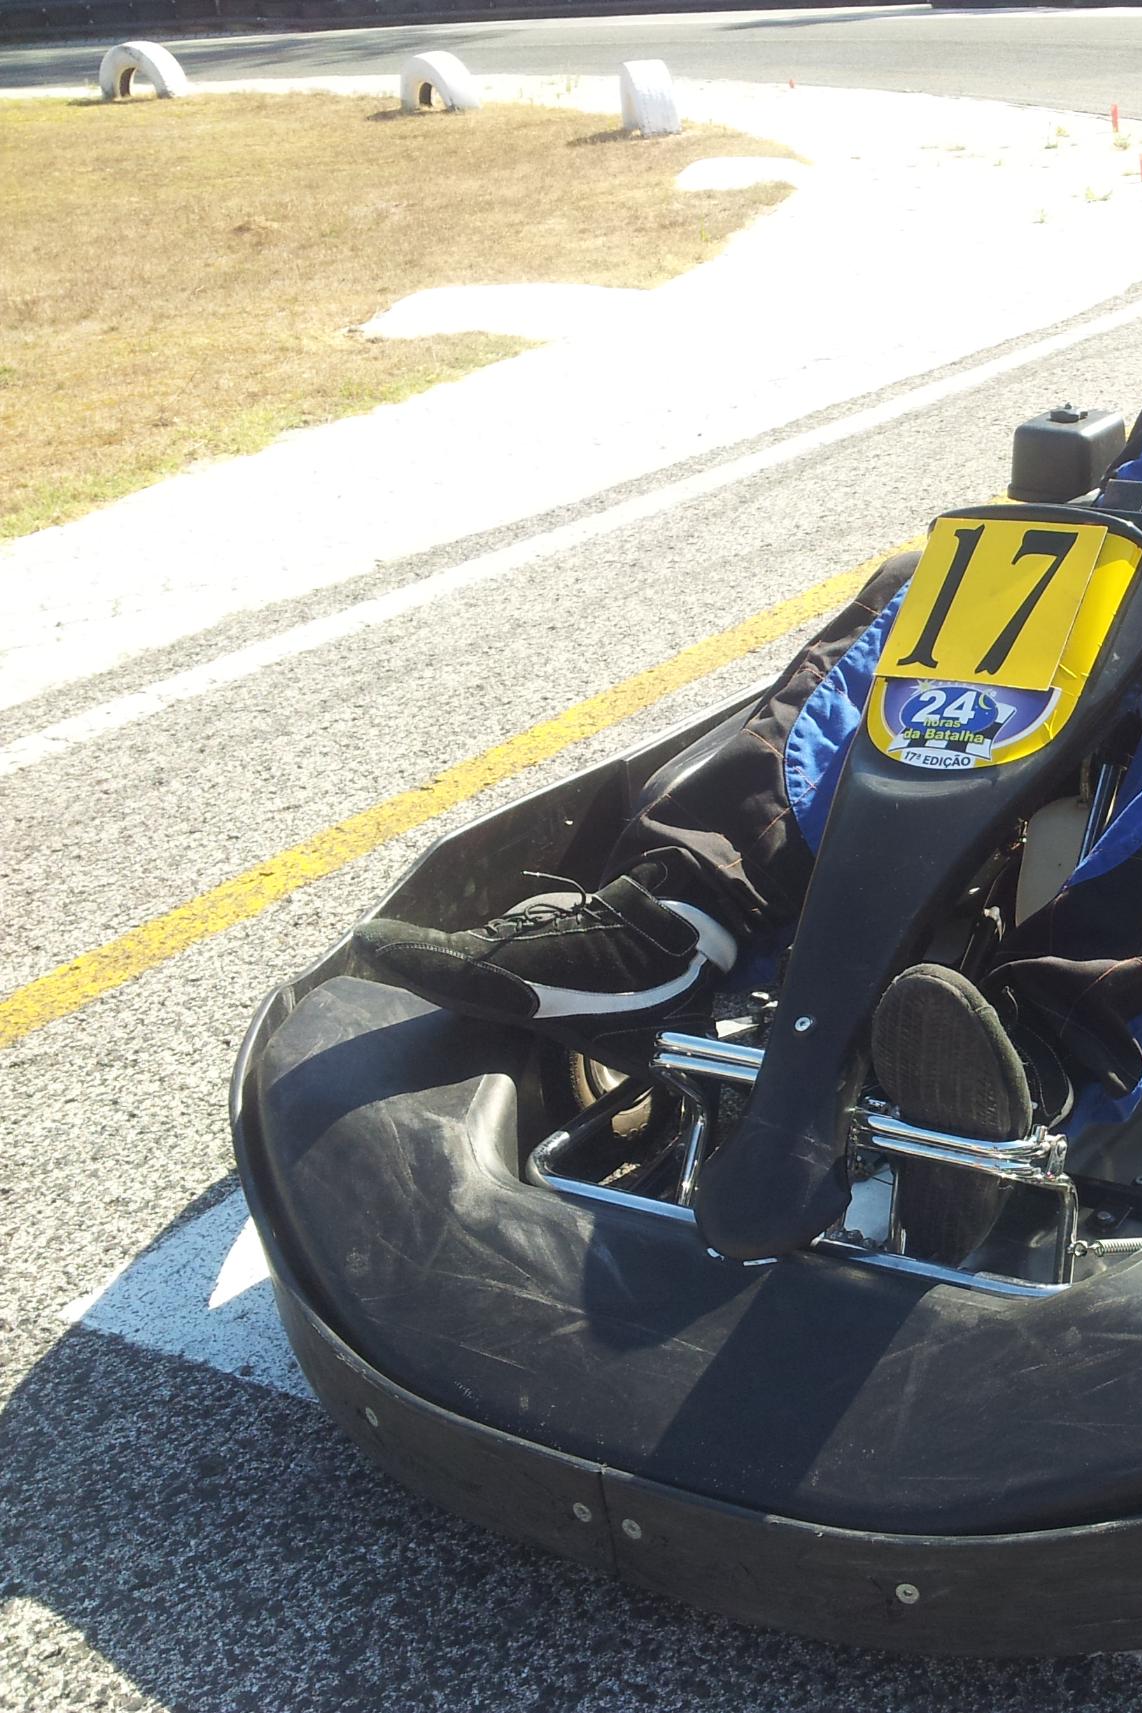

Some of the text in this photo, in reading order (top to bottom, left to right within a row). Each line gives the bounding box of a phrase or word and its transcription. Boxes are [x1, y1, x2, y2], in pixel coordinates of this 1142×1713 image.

[896, 524, 1079, 675] 17
[911, 689, 977, 724] 24
[922, 717, 961, 728] horas
[903, 728, 984, 744] da Batalha
[922, 754, 971, 768] EDIÇÃO
